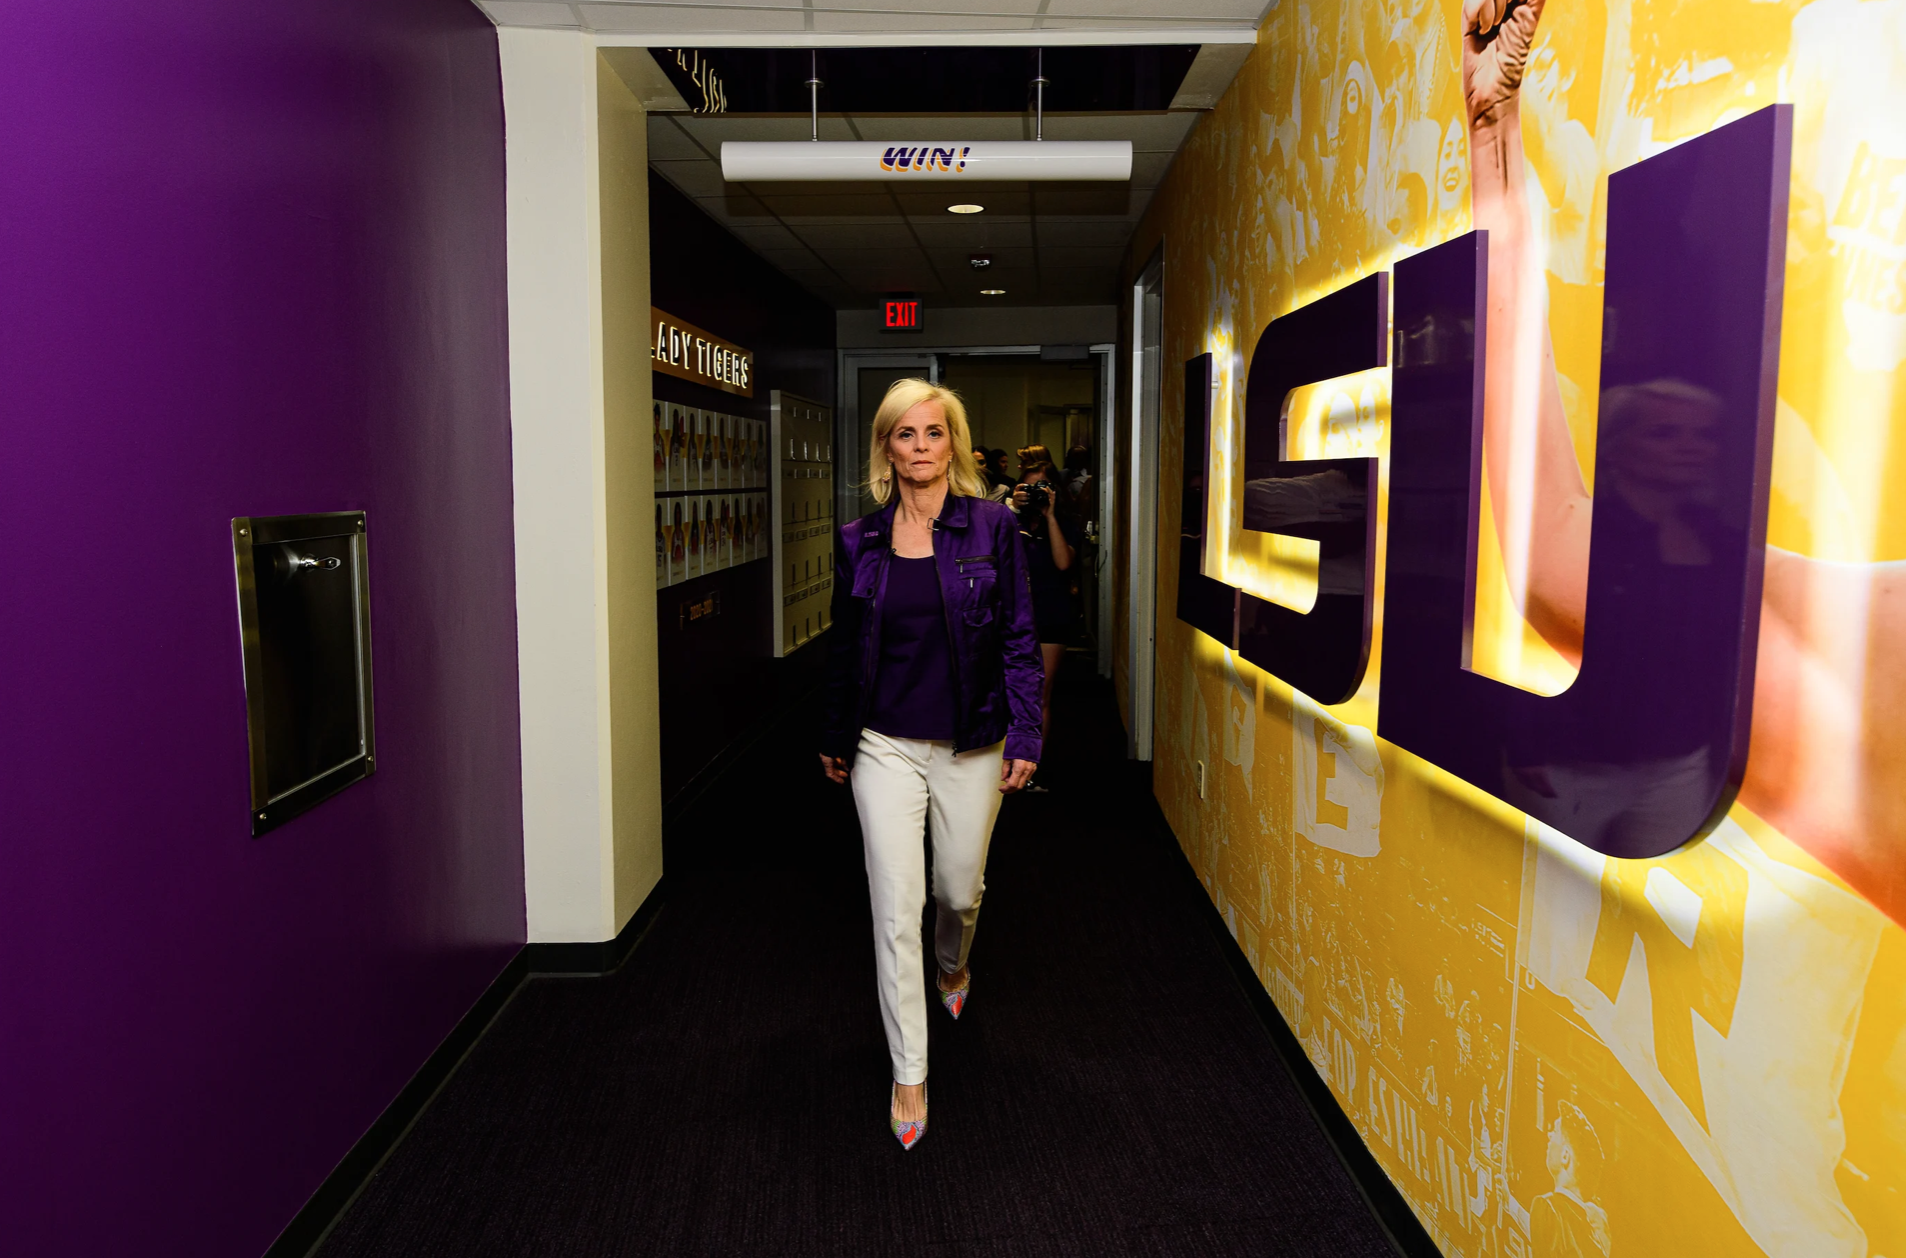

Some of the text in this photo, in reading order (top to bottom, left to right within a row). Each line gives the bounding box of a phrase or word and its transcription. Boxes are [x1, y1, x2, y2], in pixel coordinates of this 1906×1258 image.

[880, 146, 970, 173] WIN!
[886, 302, 918, 327] EXIT
[696, 337, 749, 389] TIGERS
[1177, 103, 1793, 859] LSU
